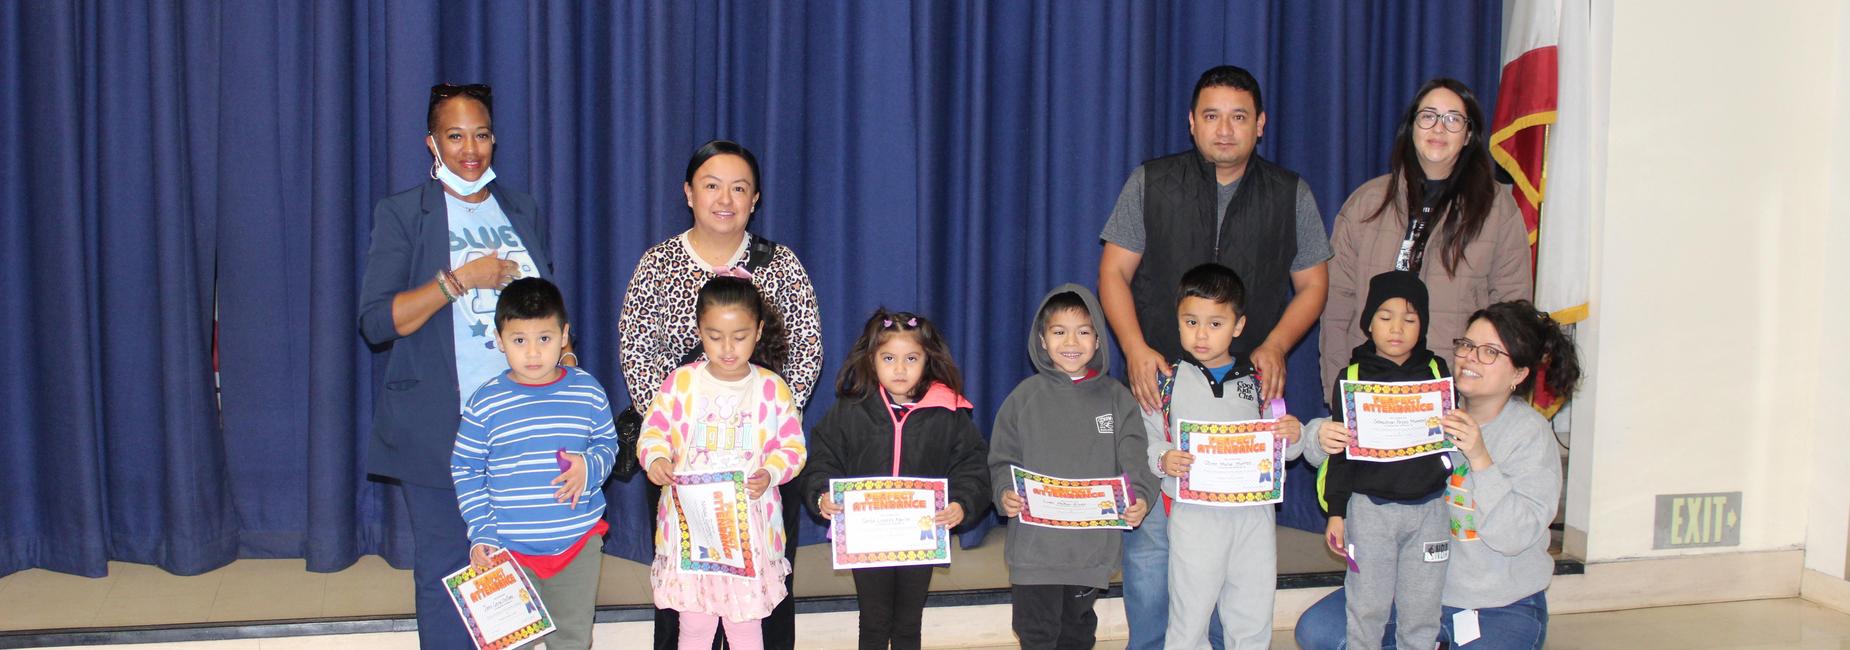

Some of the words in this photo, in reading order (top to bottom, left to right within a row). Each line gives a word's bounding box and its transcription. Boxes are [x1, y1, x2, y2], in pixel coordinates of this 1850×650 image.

[1237, 381, 1254, 391] Cool
[1239, 393, 1254, 401] Club
[1197, 443, 1266, 454] ATTENDANCE
[853, 499, 927, 512] ATTENDANCE
[1671, 496, 1727, 545] EXIT
